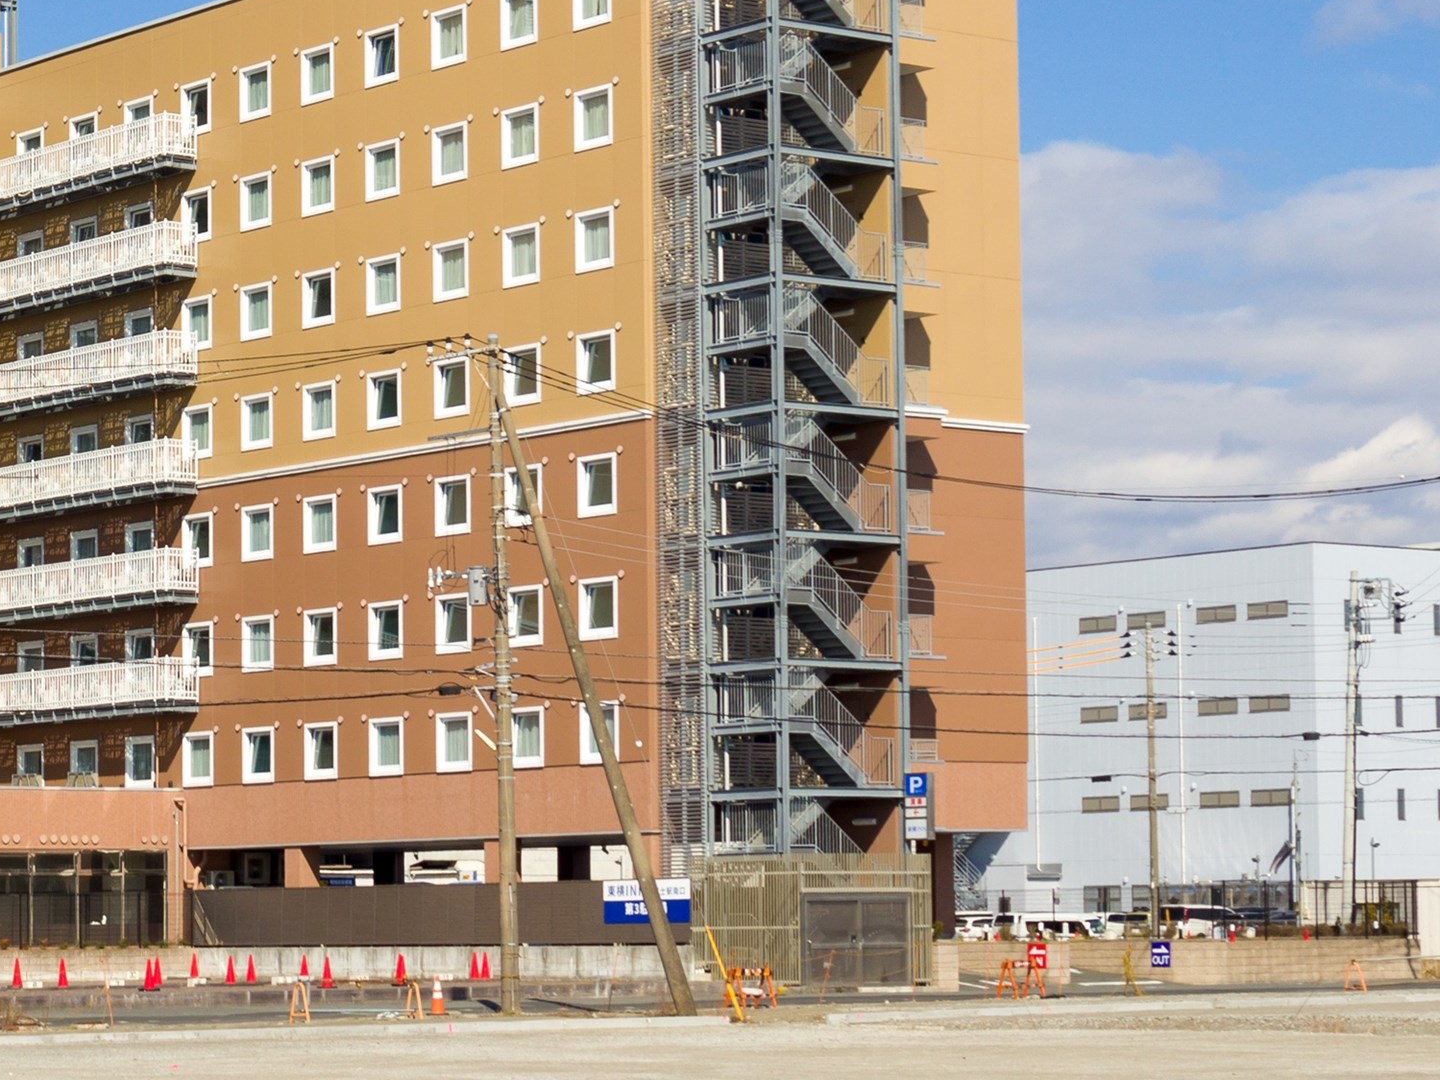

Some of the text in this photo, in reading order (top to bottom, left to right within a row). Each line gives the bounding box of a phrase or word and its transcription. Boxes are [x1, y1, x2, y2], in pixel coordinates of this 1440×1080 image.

[910, 776, 923, 794] P
[608, 885, 641, 897] 東横IN
[1152, 955, 1170, 966] OUT
